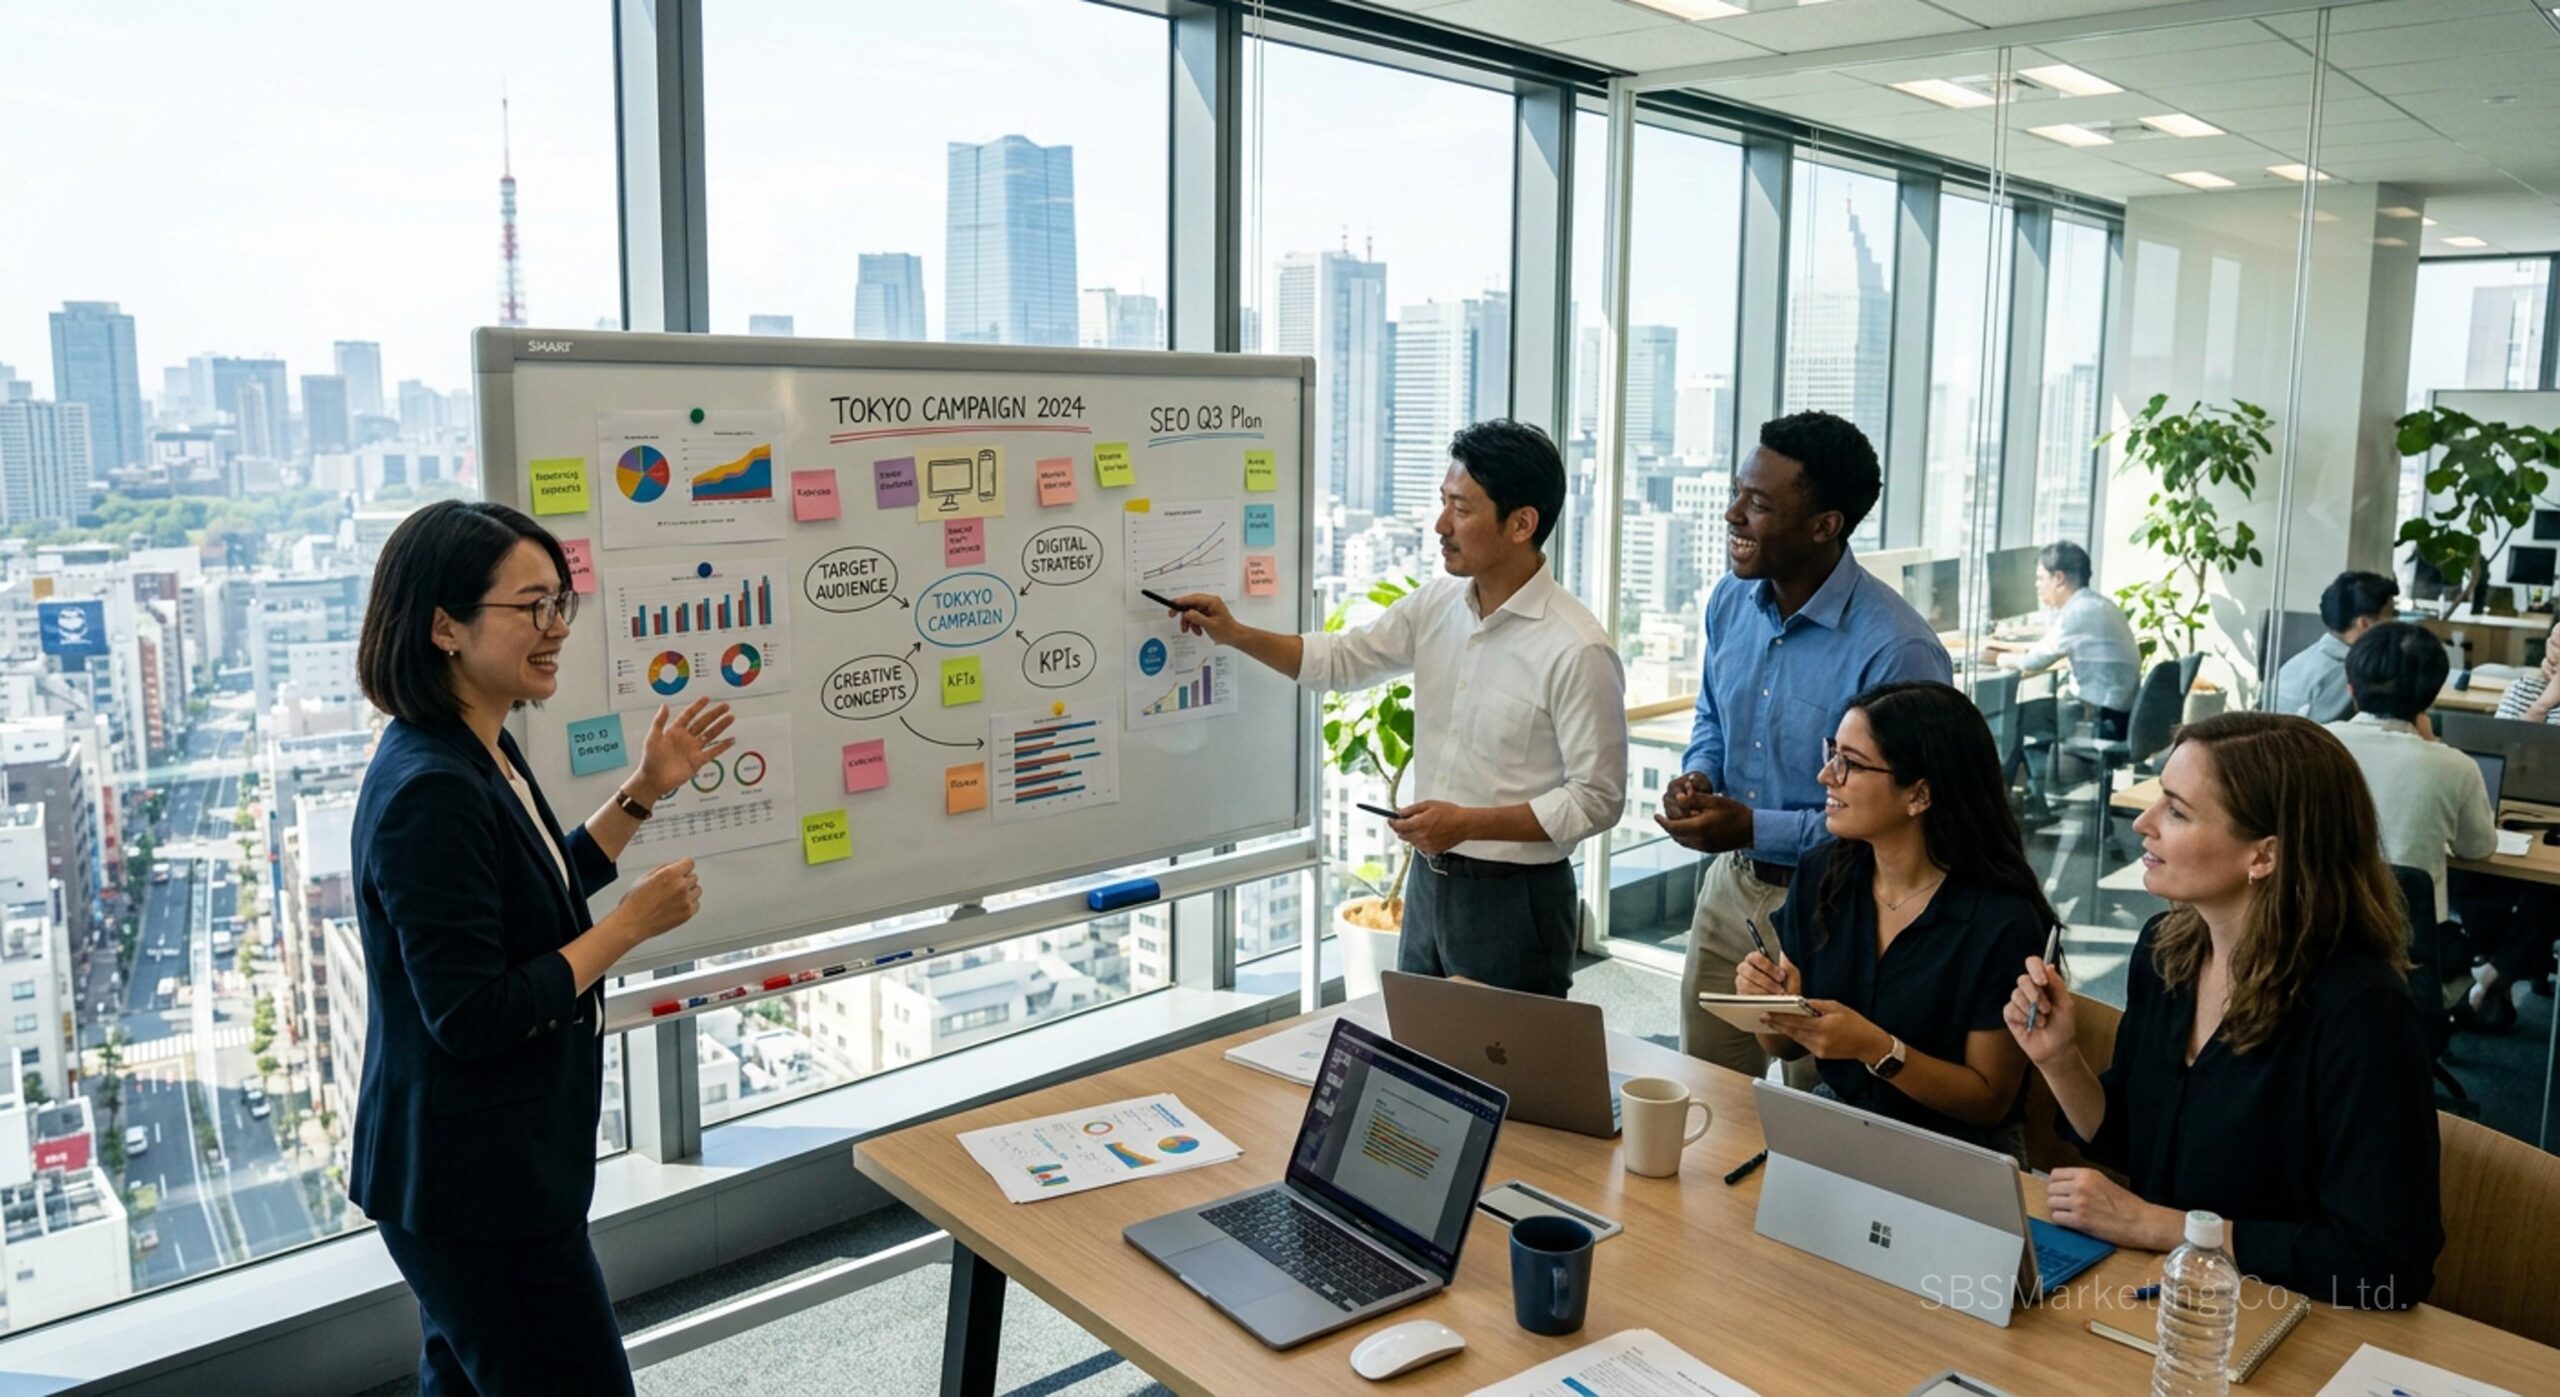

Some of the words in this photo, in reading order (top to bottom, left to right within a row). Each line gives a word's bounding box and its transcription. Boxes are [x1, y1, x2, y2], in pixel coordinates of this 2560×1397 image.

[830, 396, 912, 424] TOKYO
[922, 396, 1026, 421] CAMPAIGN
[1038, 396, 1086, 418] 2024
[1150, 406, 1190, 433] SEO
[1197, 405, 1223, 430] Q3
[1231, 405, 1263, 429] Plan
[818, 558, 879, 580] TARGET
[815, 578, 888, 600] AUDIENCE
[1039, 648, 1081, 674] KPIs
[834, 686, 907, 710] CONCEPTS
